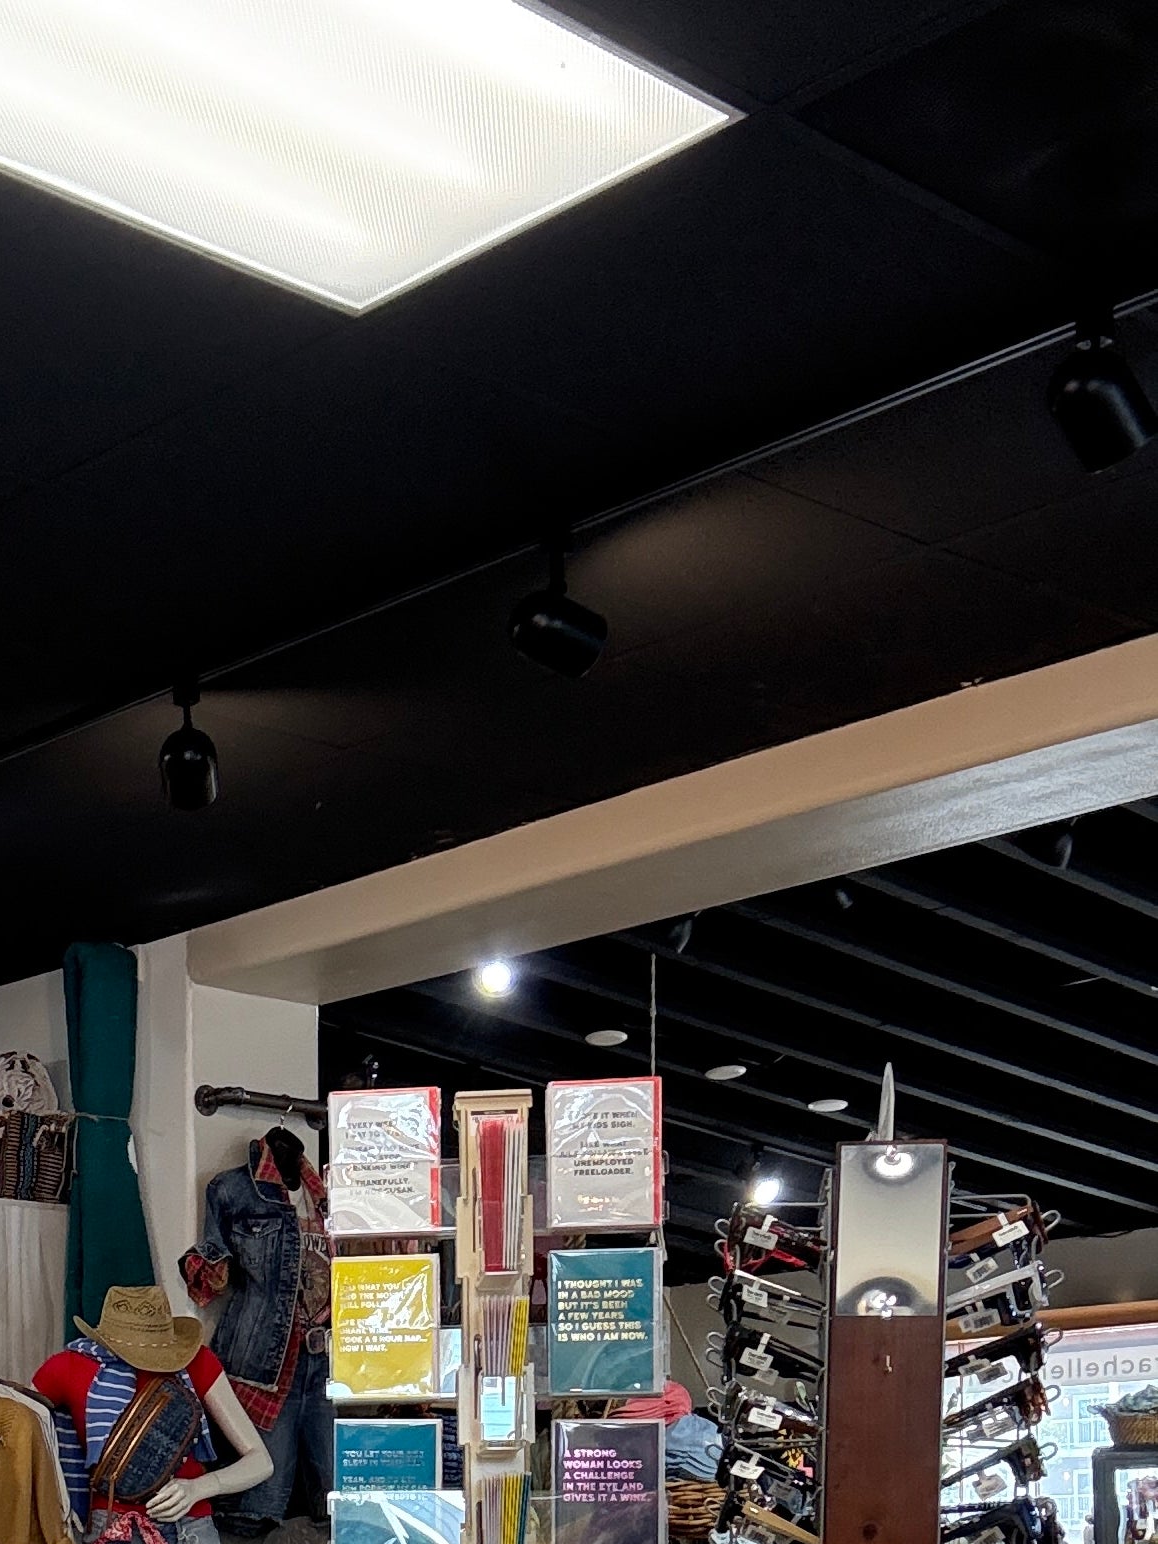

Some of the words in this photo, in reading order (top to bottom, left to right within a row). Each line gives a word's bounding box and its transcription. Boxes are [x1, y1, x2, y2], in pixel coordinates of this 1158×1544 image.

[574, 1158, 634, 1167] UNEMPLOYED
[574, 1167, 634, 1176] FREELOADER.
[557, 1280, 561, 1289] I
[563, 1279, 613, 1289] THOUGHT
[614, 1279, 618, 1288] I
[620, 1278, 643, 1288] WAS
[557, 1291, 569, 1300] IN
[570, 1291, 578, 1299] A
[580, 1290, 600, 1299] BAD
[603, 1289, 635, 1298] MOOD
[557, 1302, 579, 1311] BUT
[580, 1301, 600, 1310] IT'S
[601, 1300, 628, 1309] BEEN
[558, 1312, 566, 1321] A
[567, 1312, 589, 1320] FEW
[591, 1311, 625, 1319] YEARS
[557, 1322, 573, 1331] SO
[575, 1322, 579, 1331] I
[581, 1322, 616, 1331] GUESS
[618, 1321, 642, 1330] THIS
[557, 1333, 569, 1342] IS
[570, 1332, 596, 1341] WHO
[597, 1332, 601, 1341] I
[603, 1332, 619, 1341] AM
[620, 1332, 648, 1340] NOW.
[339, 1345, 359, 1353] NOW
[361, 1344, 364, 1352] I
[563, 1449, 571, 1458] A
[573, 1449, 617, 1458] STRONG
[563, 1460, 605, 1469] WOMAN
[606, 1460, 643, 1469] LOOKS
[563, 1472, 571, 1480] A
[573, 1471, 635, 1480] CHALLENGE
[563, 1482, 574, 1491] IN
[576, 1482, 596, 1491] THE
[598, 1482, 618, 1491] EYE
[622, 1482, 644, 1490] AND
[563, 1493, 596, 1502] GIVES
[597, 1493, 608, 1502] IT
[609, 1493, 618, 1502] A
